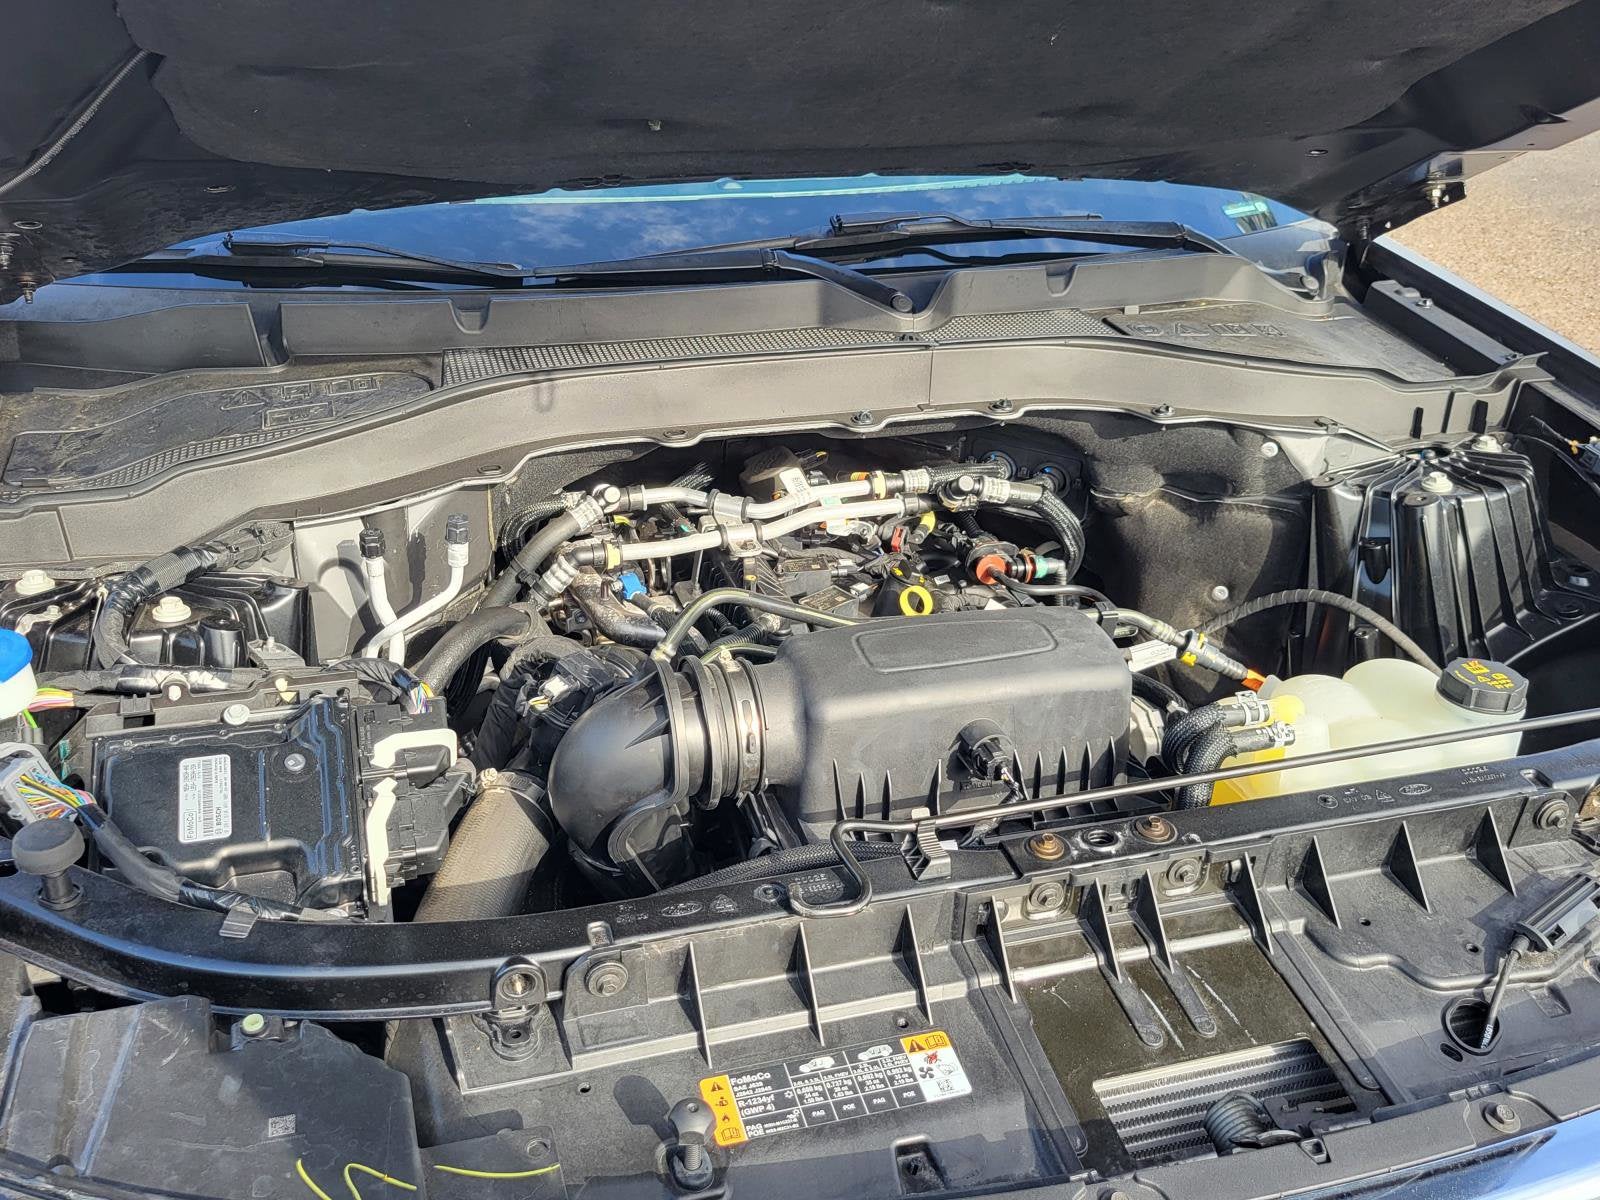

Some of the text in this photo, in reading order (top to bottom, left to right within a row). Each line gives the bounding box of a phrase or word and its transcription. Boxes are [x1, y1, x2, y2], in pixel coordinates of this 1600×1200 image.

[730, 1072, 771, 1085] FoMoCo
[738, 1094, 775, 1108] R-1234yf
[741, 1103, 775, 1117] (GWP 4)
[748, 1129, 765, 1137] POE
